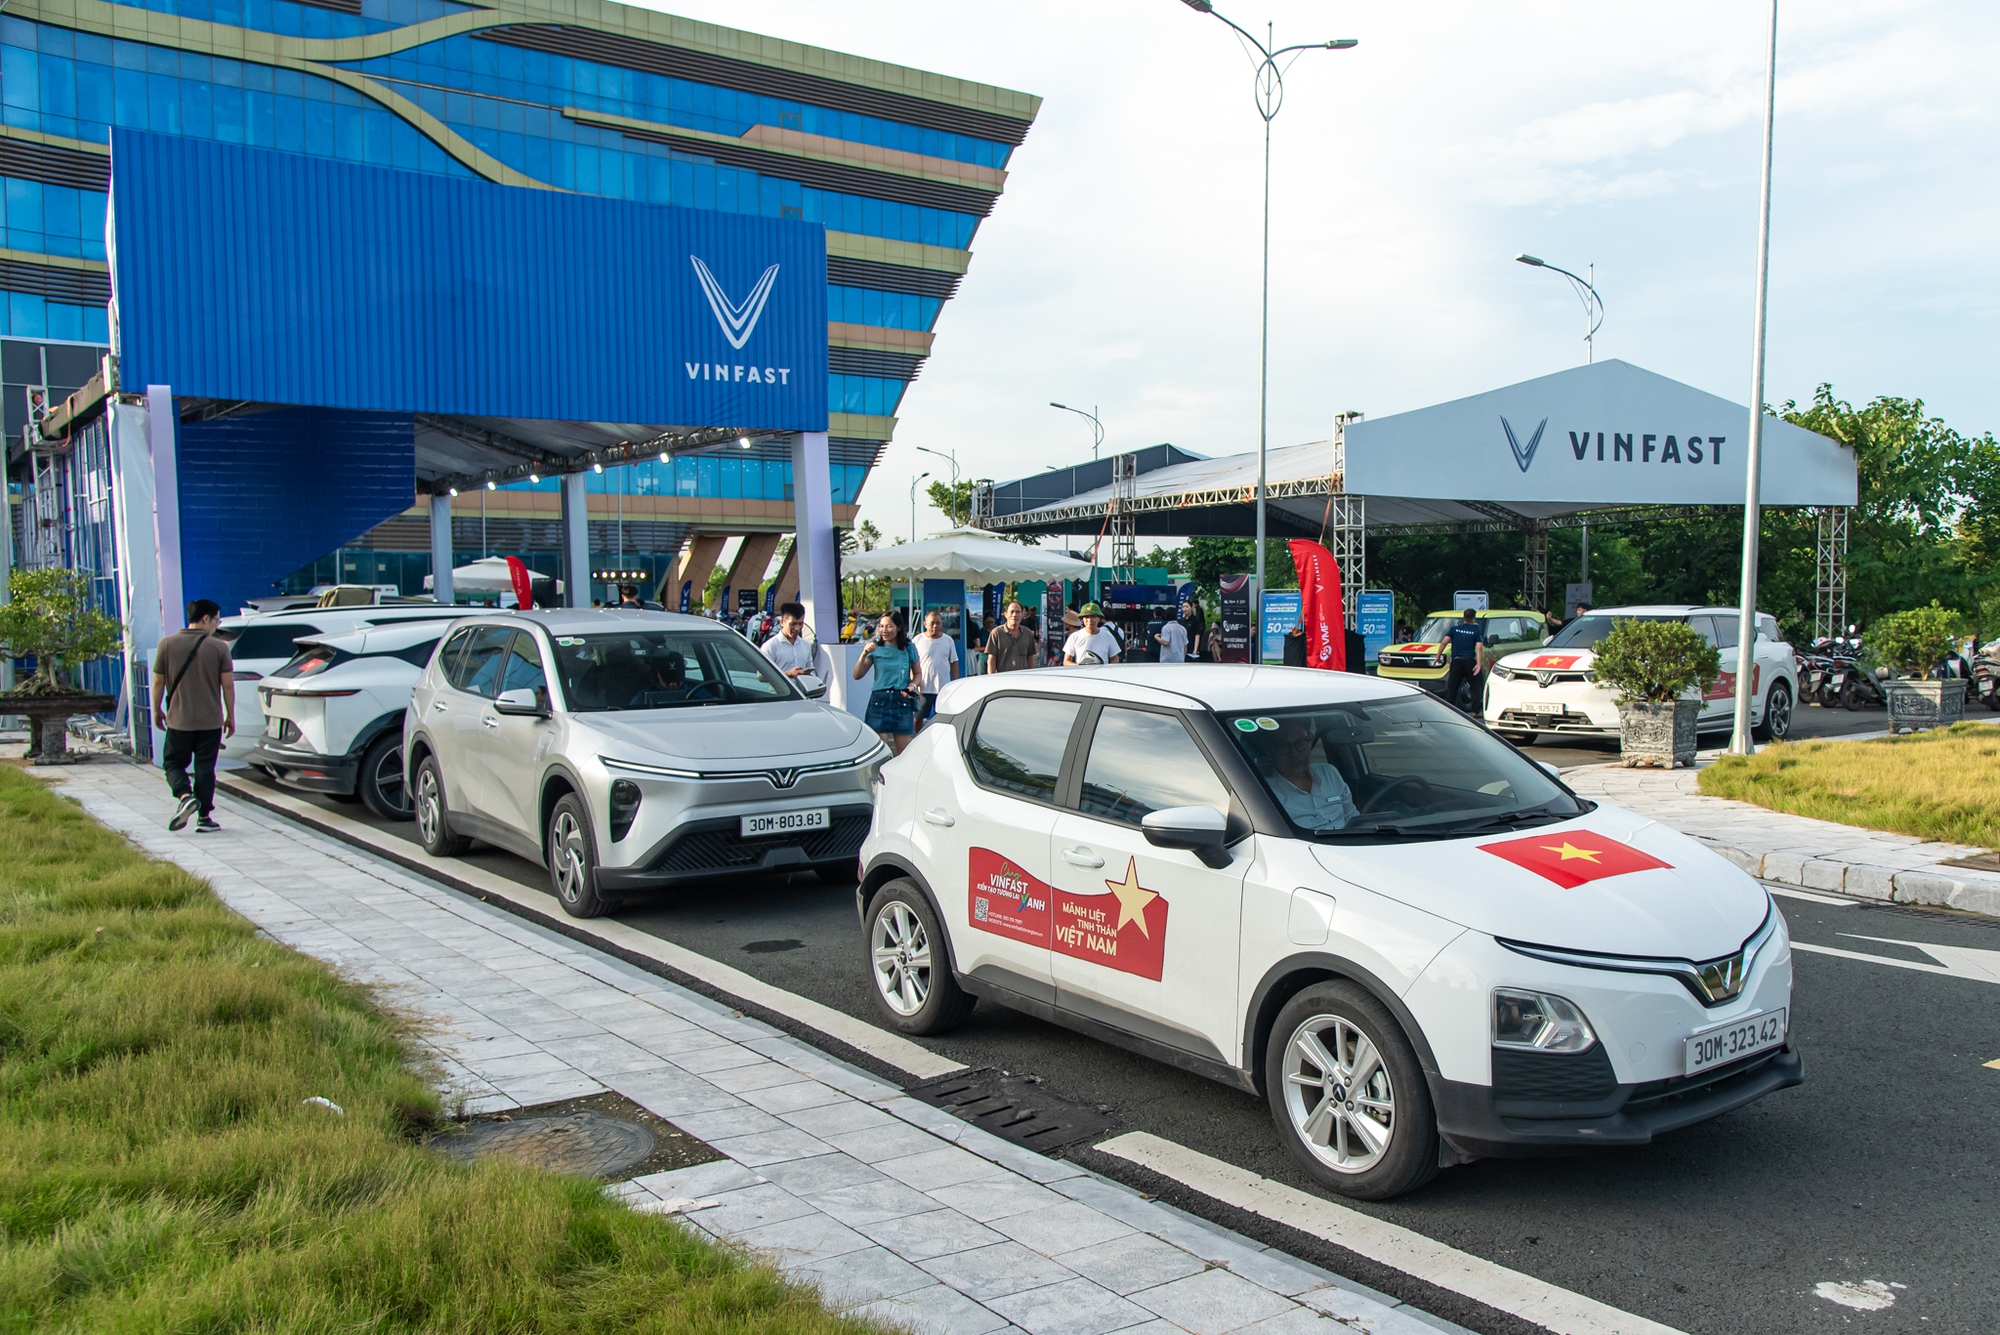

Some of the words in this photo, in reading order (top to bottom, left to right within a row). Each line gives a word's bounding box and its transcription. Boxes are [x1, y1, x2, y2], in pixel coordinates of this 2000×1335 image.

[685, 362, 791, 385] VINFAST
[1568, 430, 1727, 465] VINFAST
[1312, 554, 1321, 582] VINFAST
[1266, 622, 1282, 633] 50
[1320, 621, 1330, 646] VMF
[1362, 623, 1375, 635] 50
[1524, 704, 1559, 713] 30L-925.72
[750, 812, 822, 832] 30M-803.83
[990, 873, 1029, 895] VINFAST
[1017, 893, 1046, 913] XANH
[1077, 919, 1095, 932] TINH
[1088, 908, 1106, 923] LIỆT
[1055, 925, 1085, 948] VIỆT
[1086, 933, 1117, 957] NAM
[1694, 1017, 1777, 1065] 30M-323.42
